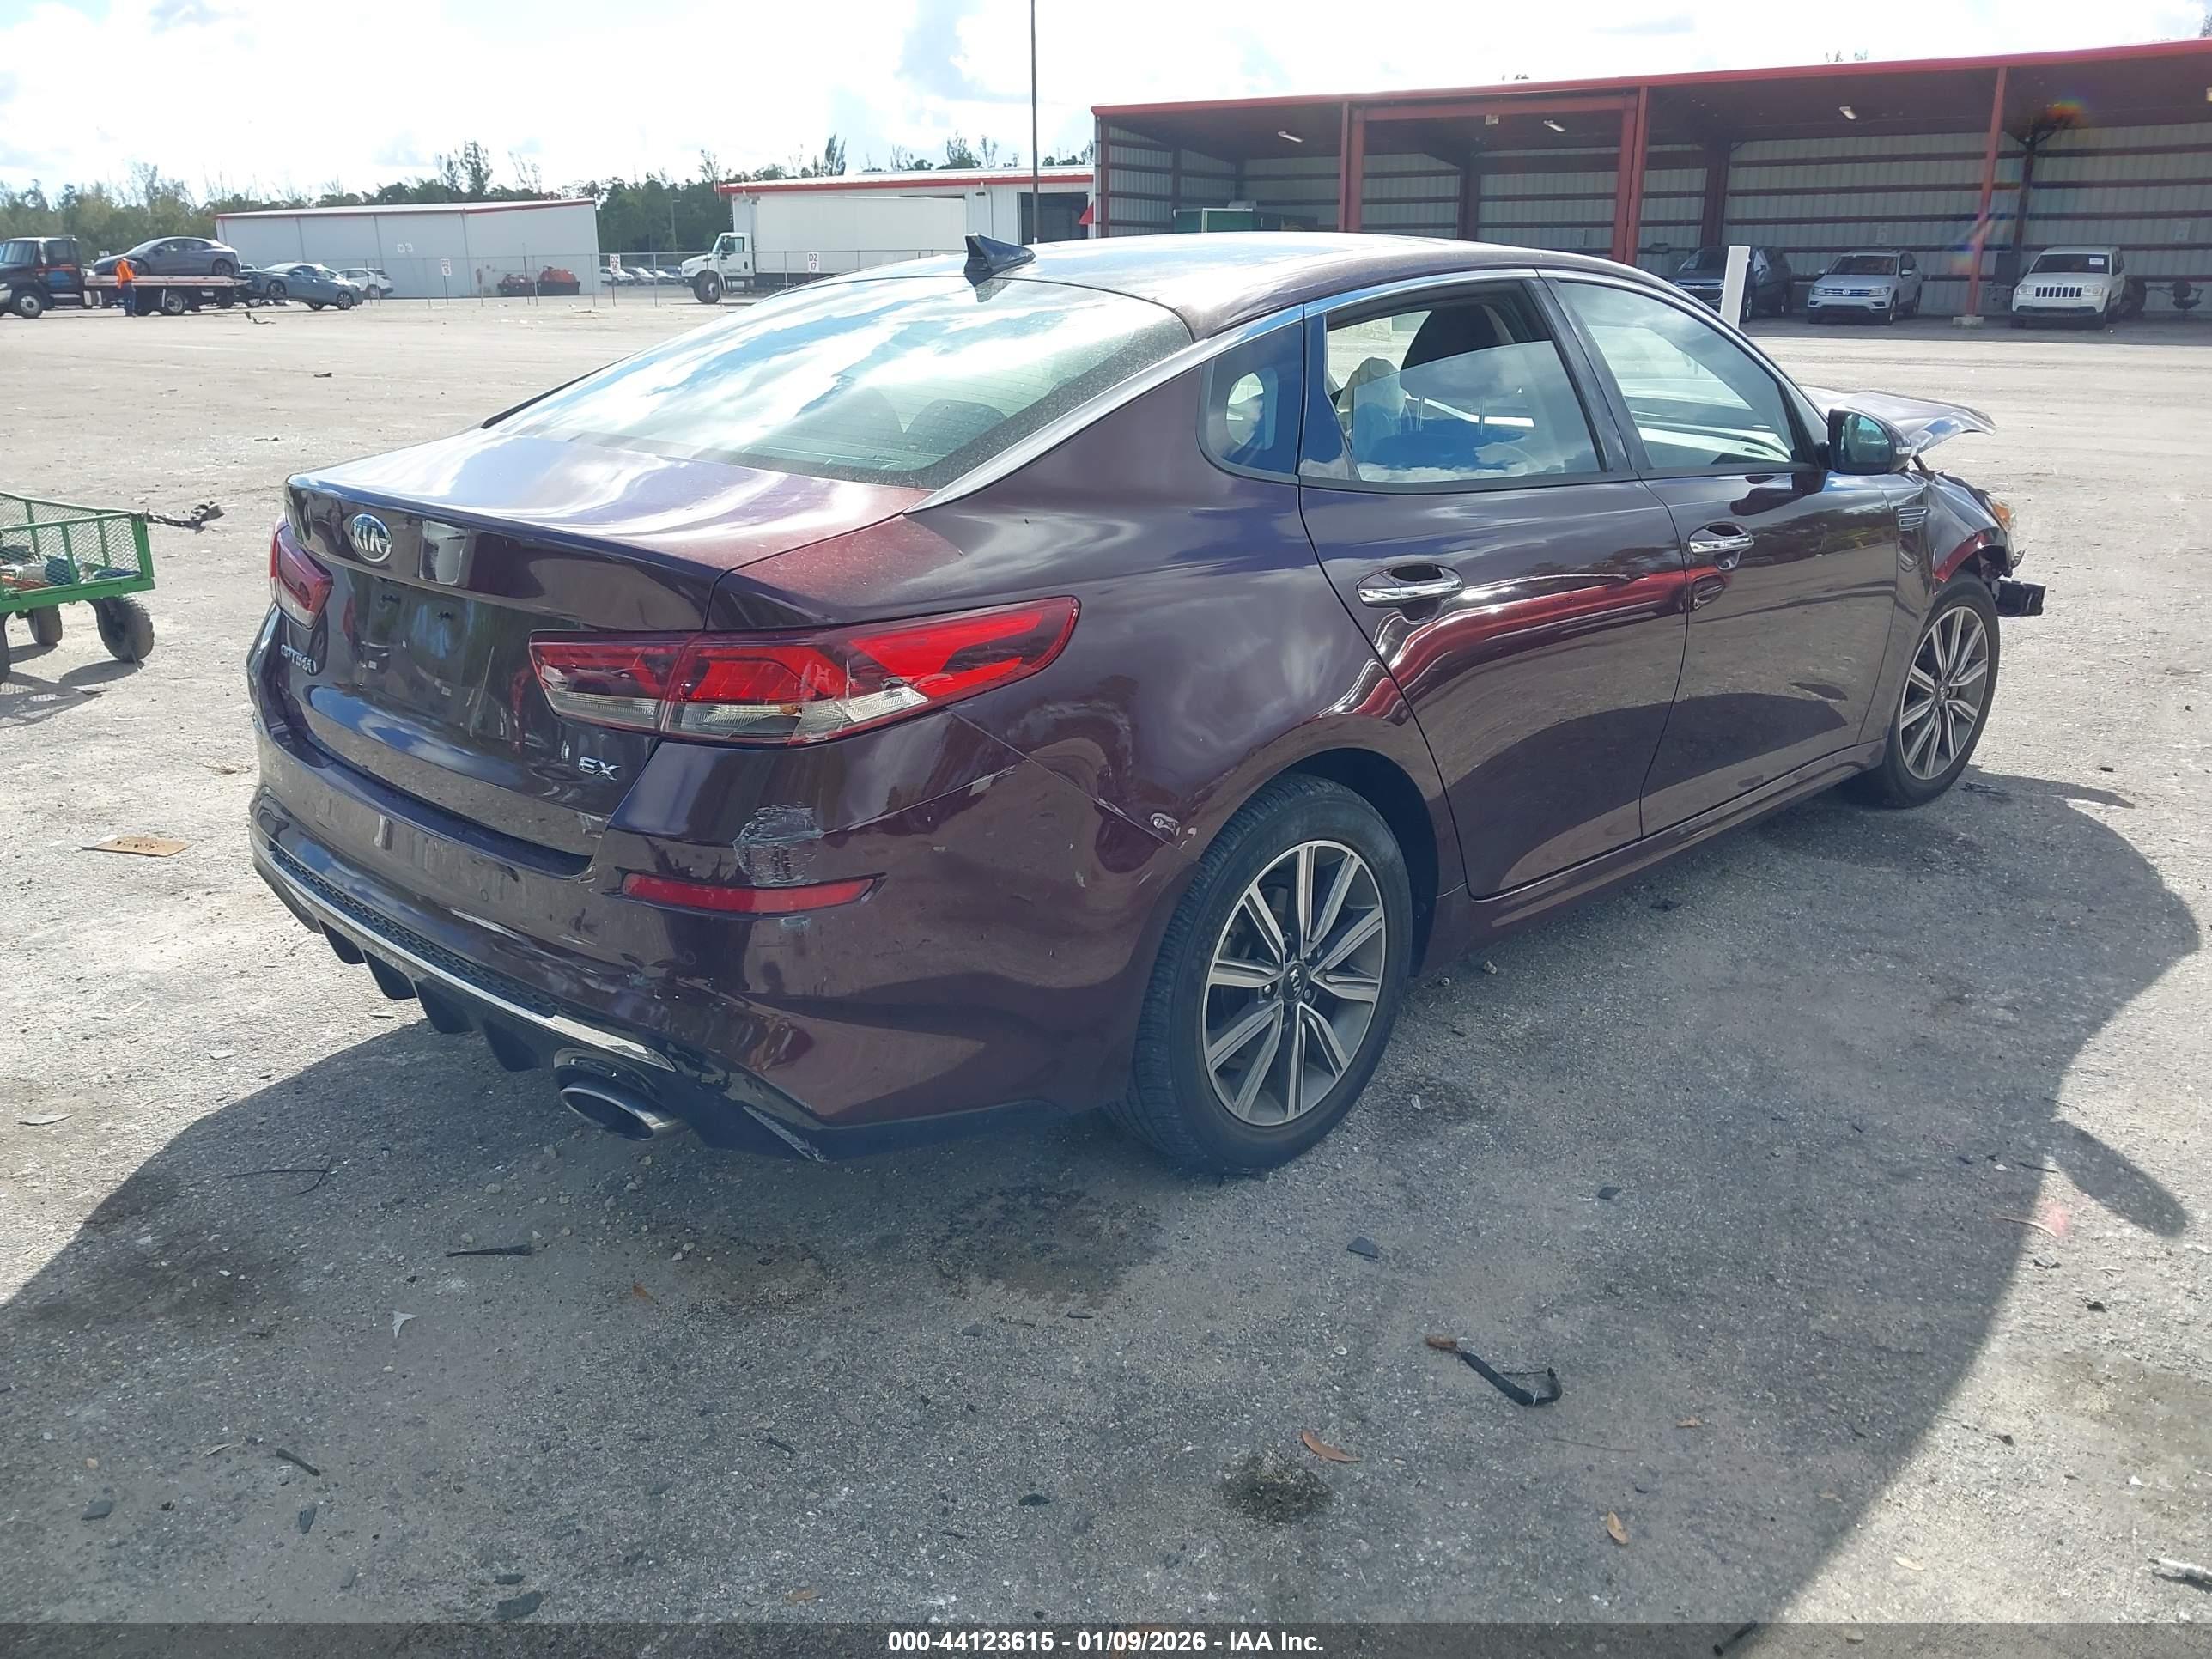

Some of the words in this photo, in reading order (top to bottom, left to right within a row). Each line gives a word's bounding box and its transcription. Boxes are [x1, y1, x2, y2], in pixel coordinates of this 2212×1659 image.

[353, 522, 383, 553] KIA
[579, 757, 622, 781] EX
[1289, 969, 1302, 996] KIA
